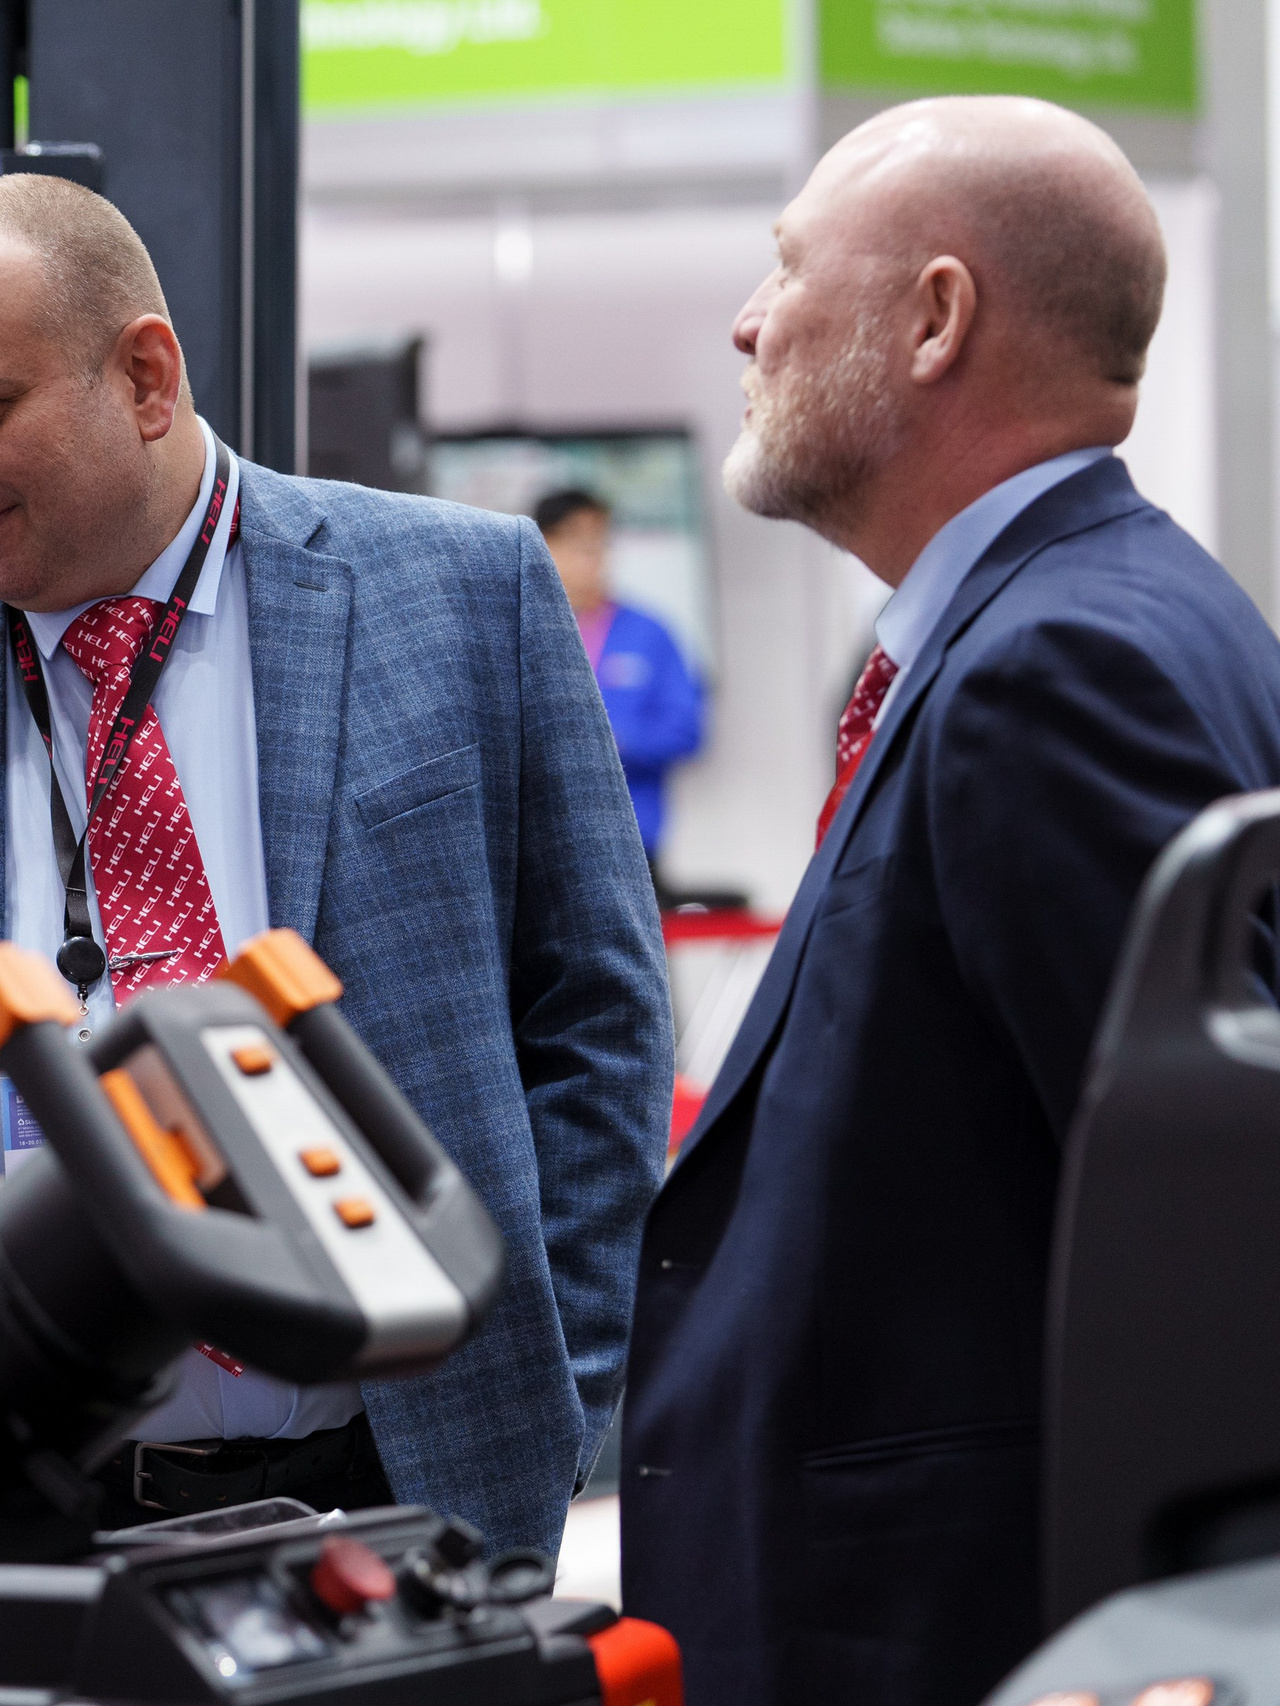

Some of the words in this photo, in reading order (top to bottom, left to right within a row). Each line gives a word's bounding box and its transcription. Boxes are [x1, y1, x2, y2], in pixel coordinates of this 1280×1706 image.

[201, 478, 226, 545] HELI
[77, 613, 98, 626] ELI
[98, 603, 135, 624] HELI
[148, 595, 188, 662] HELI
[11, 622, 38, 681] HELI
[77, 630, 110, 650] HELI
[87, 743, 105, 787] HELI
[98, 717, 135, 784] HELI
[134, 743, 162, 779] HELI
[106, 757, 131, 800] HELI
[134, 775, 163, 815] HELI
[104, 794, 131, 837] HELI
[135, 811, 162, 854] HELI
[105, 831, 131, 874] HELI
[136, 847, 163, 891] HELI
[166, 827, 194, 870] HELI
[103, 869, 132, 910] HELI
[133, 885, 164, 925] HELI
[166, 864, 194, 907] HELI
[104, 904, 132, 943] HELI
[163, 901, 194, 942] HELI
[160, 936, 193, 973] HELI
